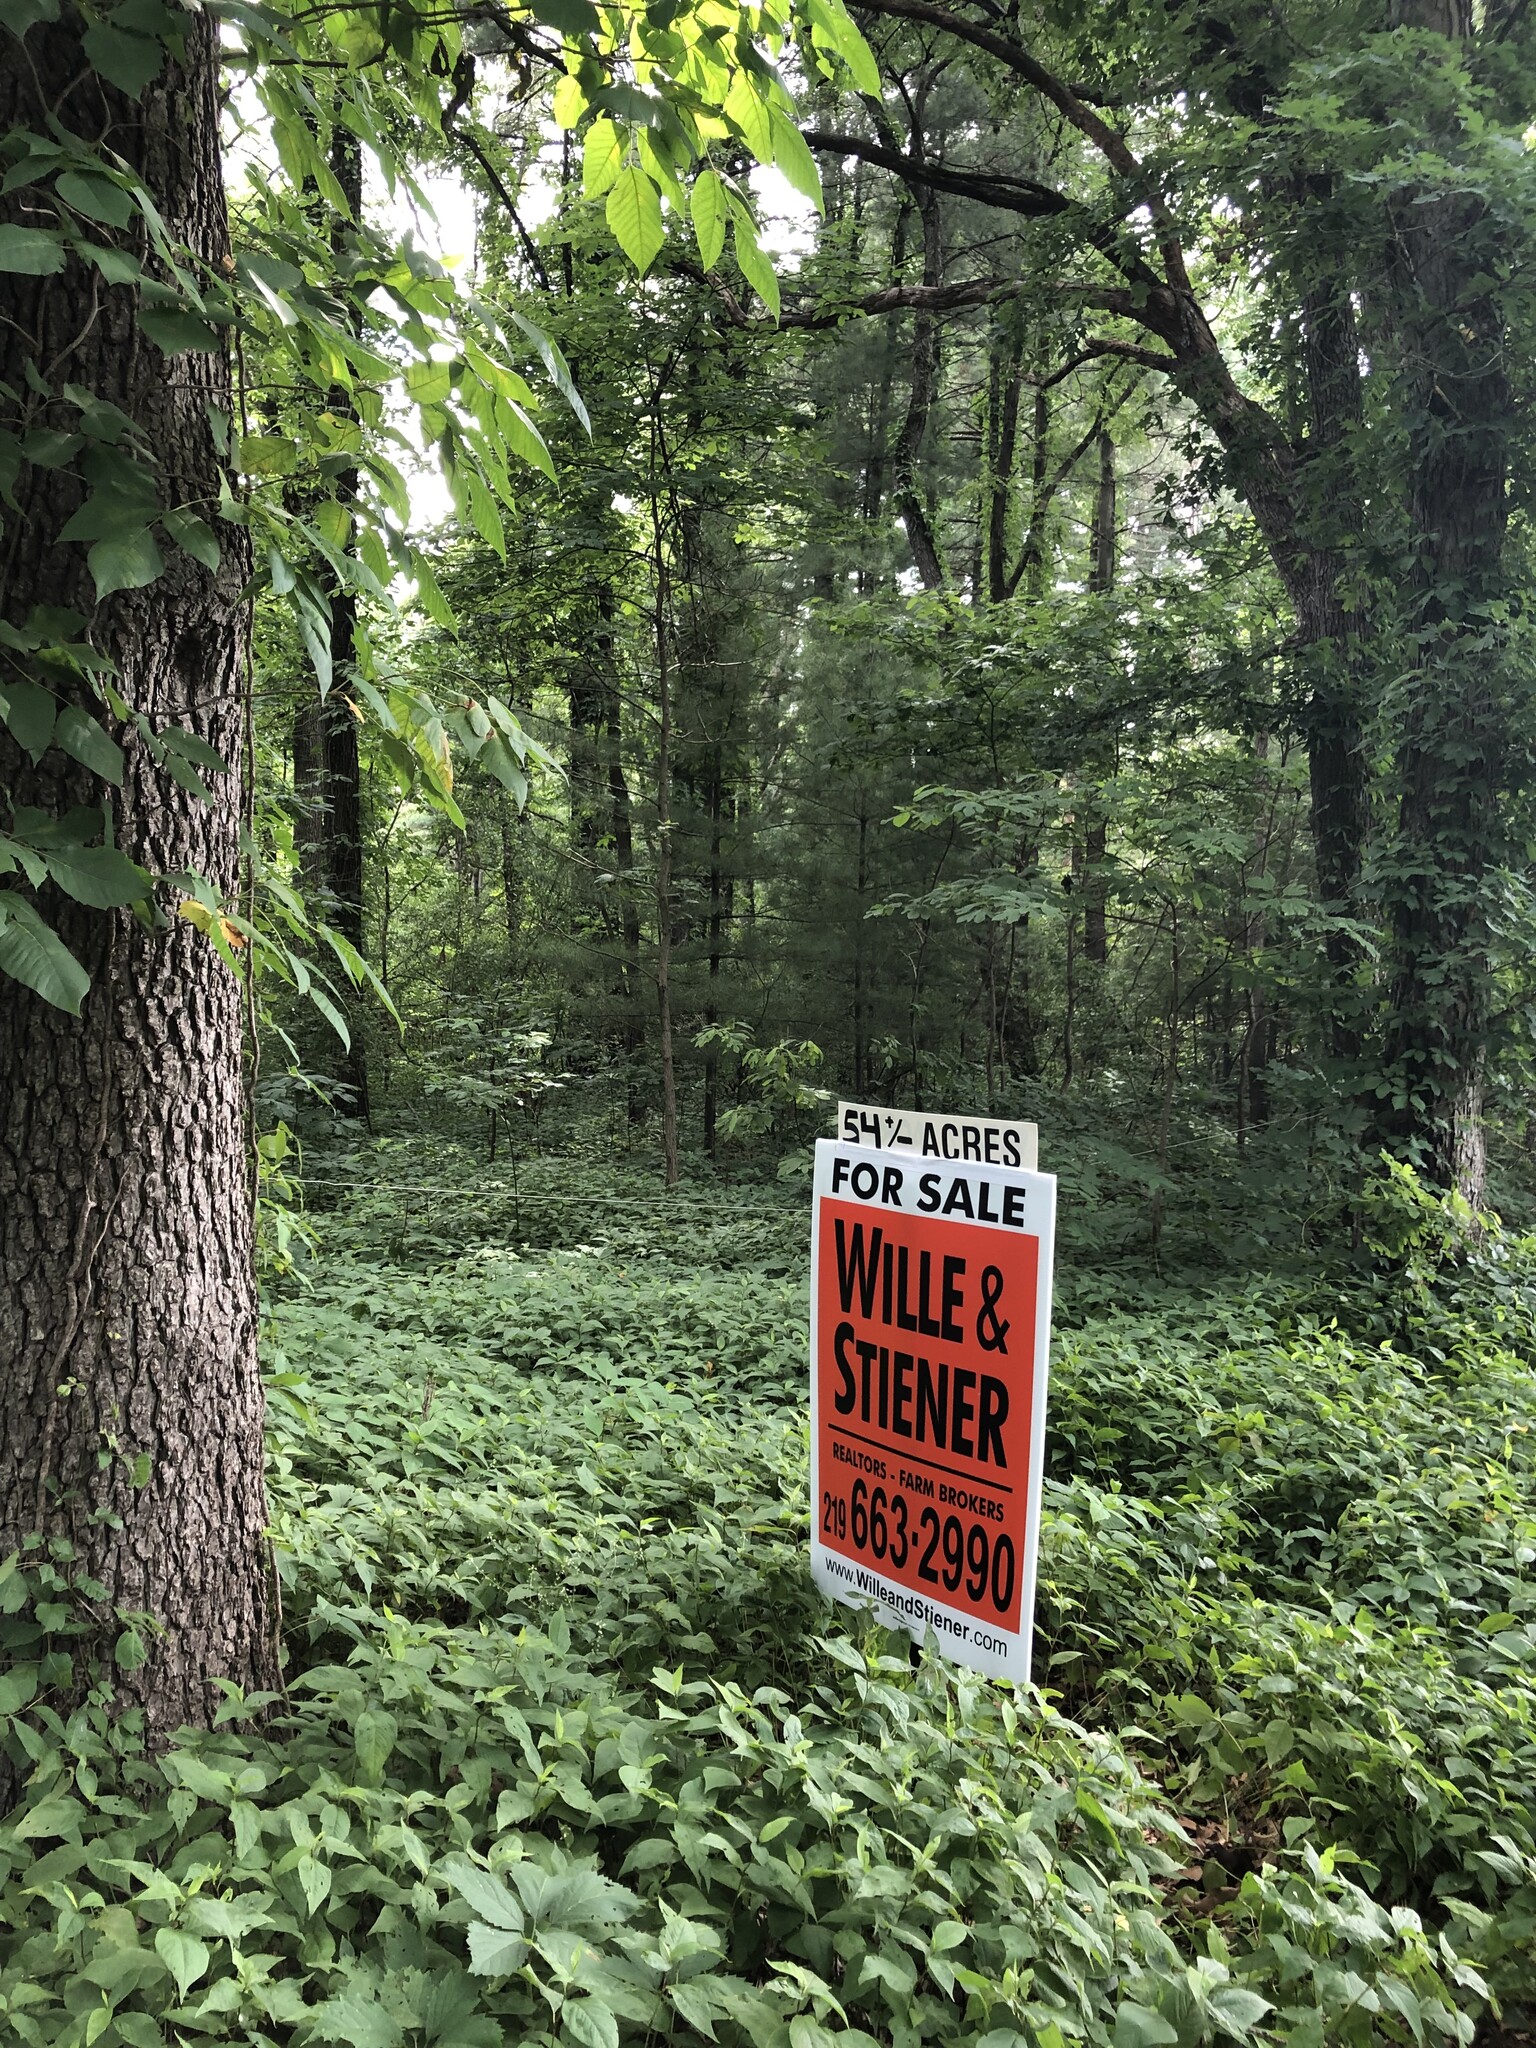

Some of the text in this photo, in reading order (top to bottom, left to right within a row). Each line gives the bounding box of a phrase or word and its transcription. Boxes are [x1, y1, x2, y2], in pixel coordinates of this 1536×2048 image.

[922, 1122, 1021, 1168] ACRES
[831, 1157, 1026, 1227] FOR SALE
[976, 1265, 1010, 1355] &
[834, 1321, 1009, 1469] STIENER
[823, 1491, 847, 1541] 219
[832, 1441, 887, 1480] REALTORS
[899, 1469, 935, 1499] FARM
[939, 1486, 1005, 1523] BROKERS
[825, 1557, 1008, 1658] www.WilleandStiener.com
